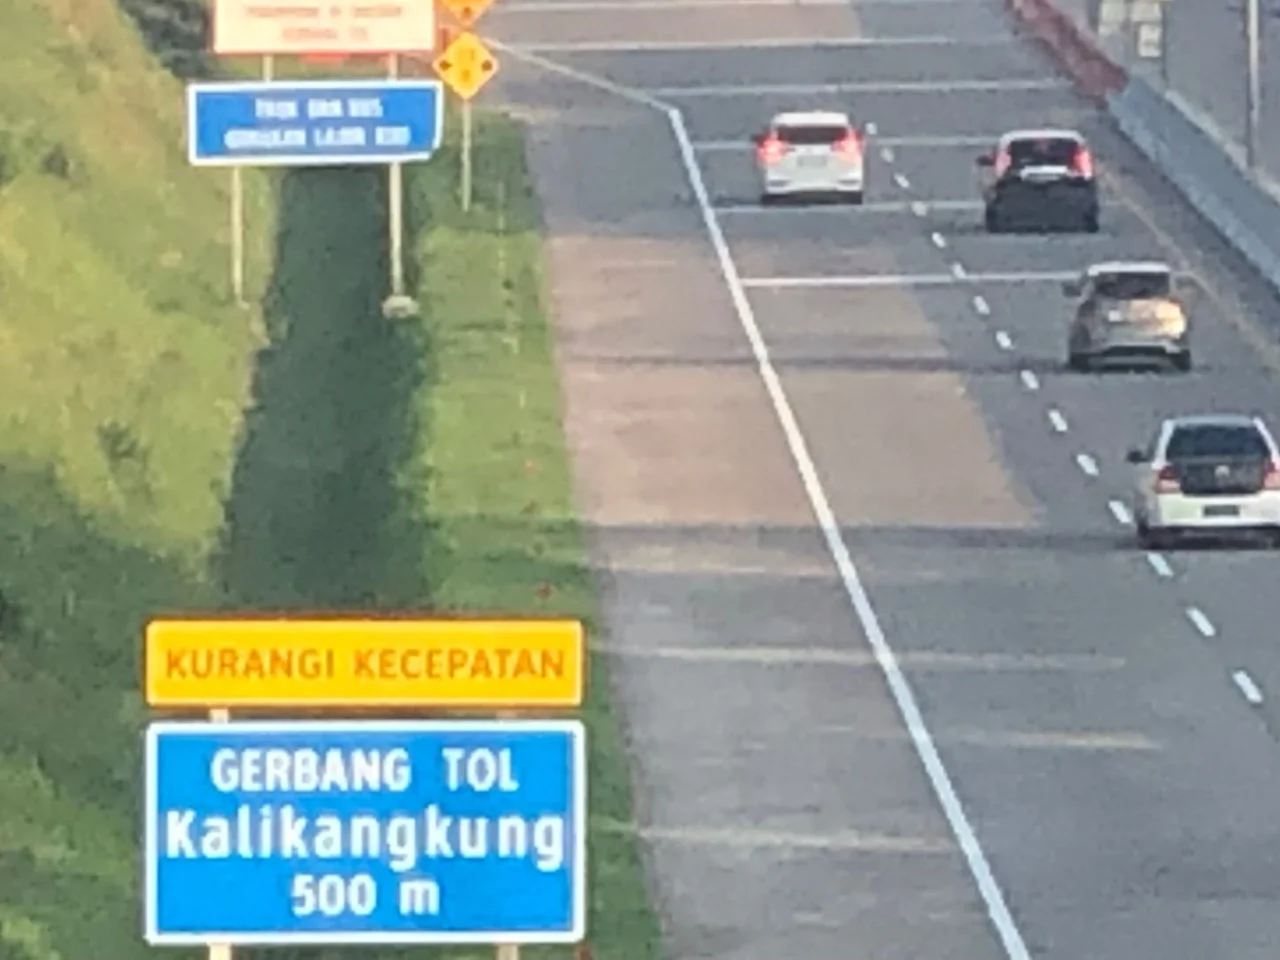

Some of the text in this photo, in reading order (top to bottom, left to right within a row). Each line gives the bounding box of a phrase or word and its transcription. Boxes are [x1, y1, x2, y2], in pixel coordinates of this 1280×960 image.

[165, 648, 567, 679] KURANGI KECEPATAN
[210, 747, 519, 792] GERBANG TOL
[166, 804, 565, 872] Kalikangkung
[291, 874, 440, 916] 500 m
